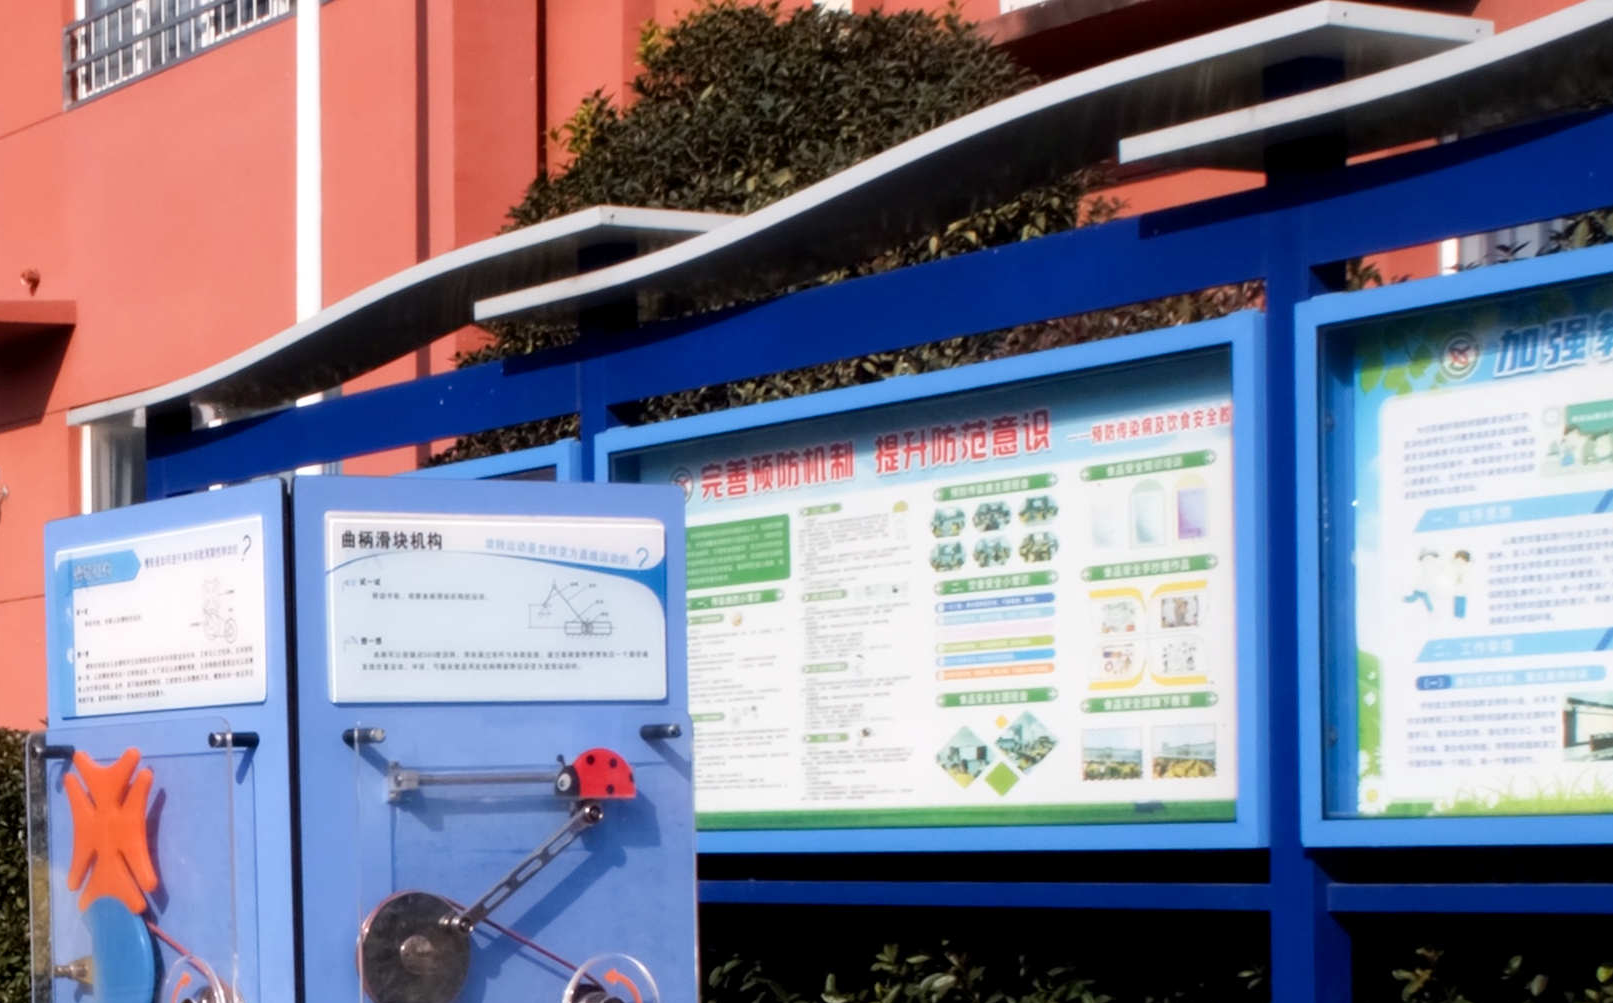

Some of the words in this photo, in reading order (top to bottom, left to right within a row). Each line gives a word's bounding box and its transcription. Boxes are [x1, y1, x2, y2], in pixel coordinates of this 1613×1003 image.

[700, 441, 855, 498] 完善预防机制
[875, 409, 1052, 475] 提升防范意识
[341, 530, 443, 550] 曲柄滑块机构
[485, 539, 629, 566] 旋转运动是怎样变为直线运动的
